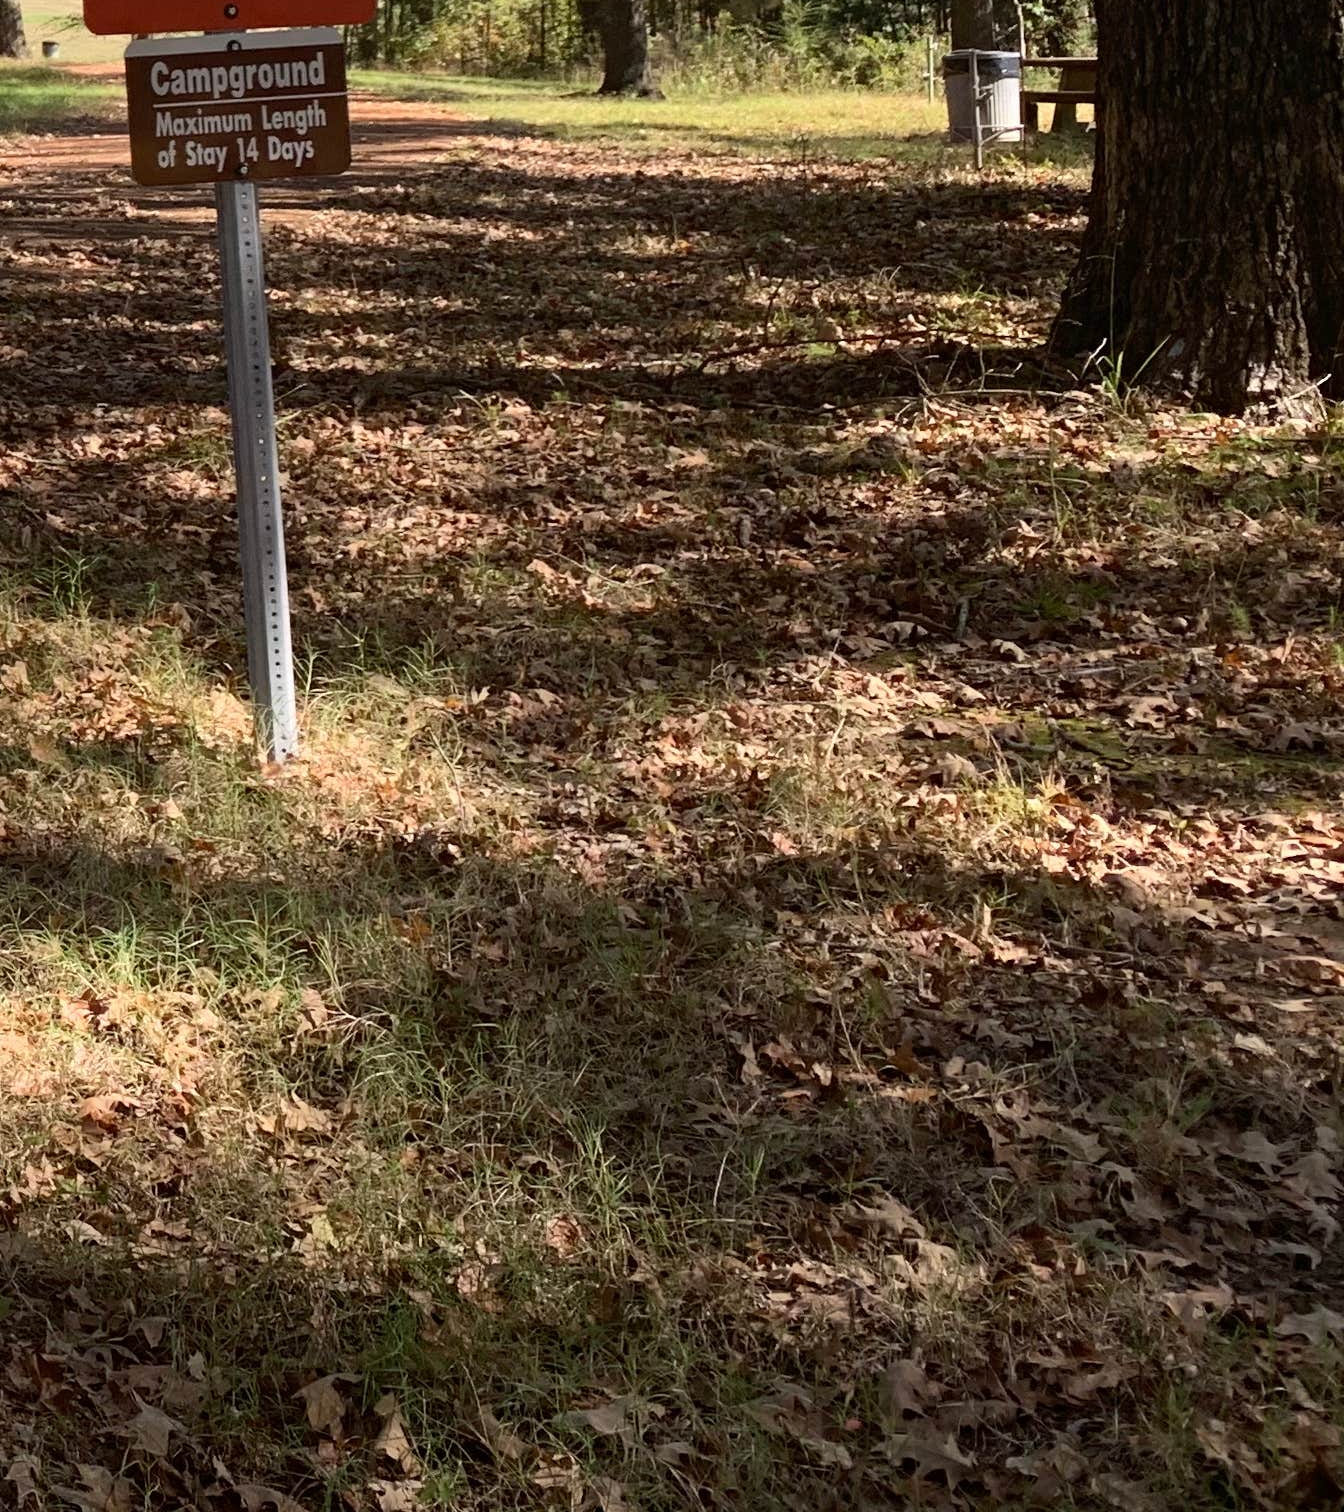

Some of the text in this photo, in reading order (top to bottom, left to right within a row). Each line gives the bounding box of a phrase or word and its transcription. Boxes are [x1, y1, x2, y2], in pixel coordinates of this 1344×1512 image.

[150, 51, 326, 99] Campground
[155, 99, 327, 137] Maximum Length
[157, 136, 314, 173] of Stay 14 Days
